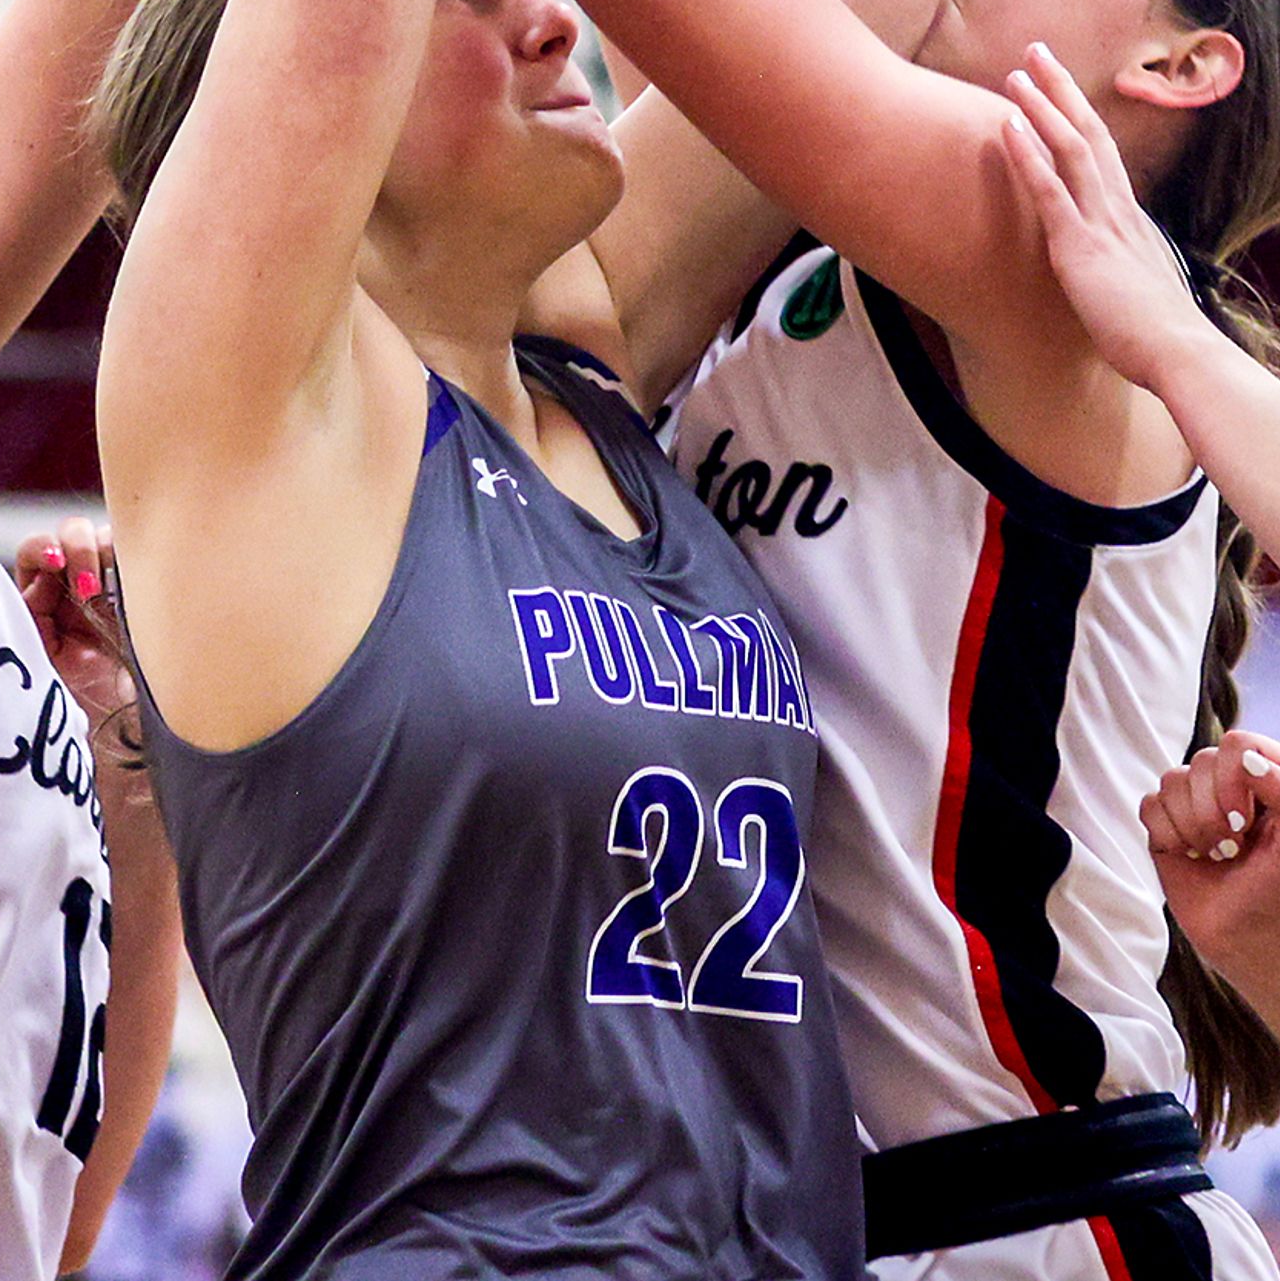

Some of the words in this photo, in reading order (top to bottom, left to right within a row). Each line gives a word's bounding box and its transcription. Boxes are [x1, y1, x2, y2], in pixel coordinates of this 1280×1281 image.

[692, 429, 848, 538] ton
[509, 586, 818, 738] PULLMA
[586, 765, 806, 1024] 22
